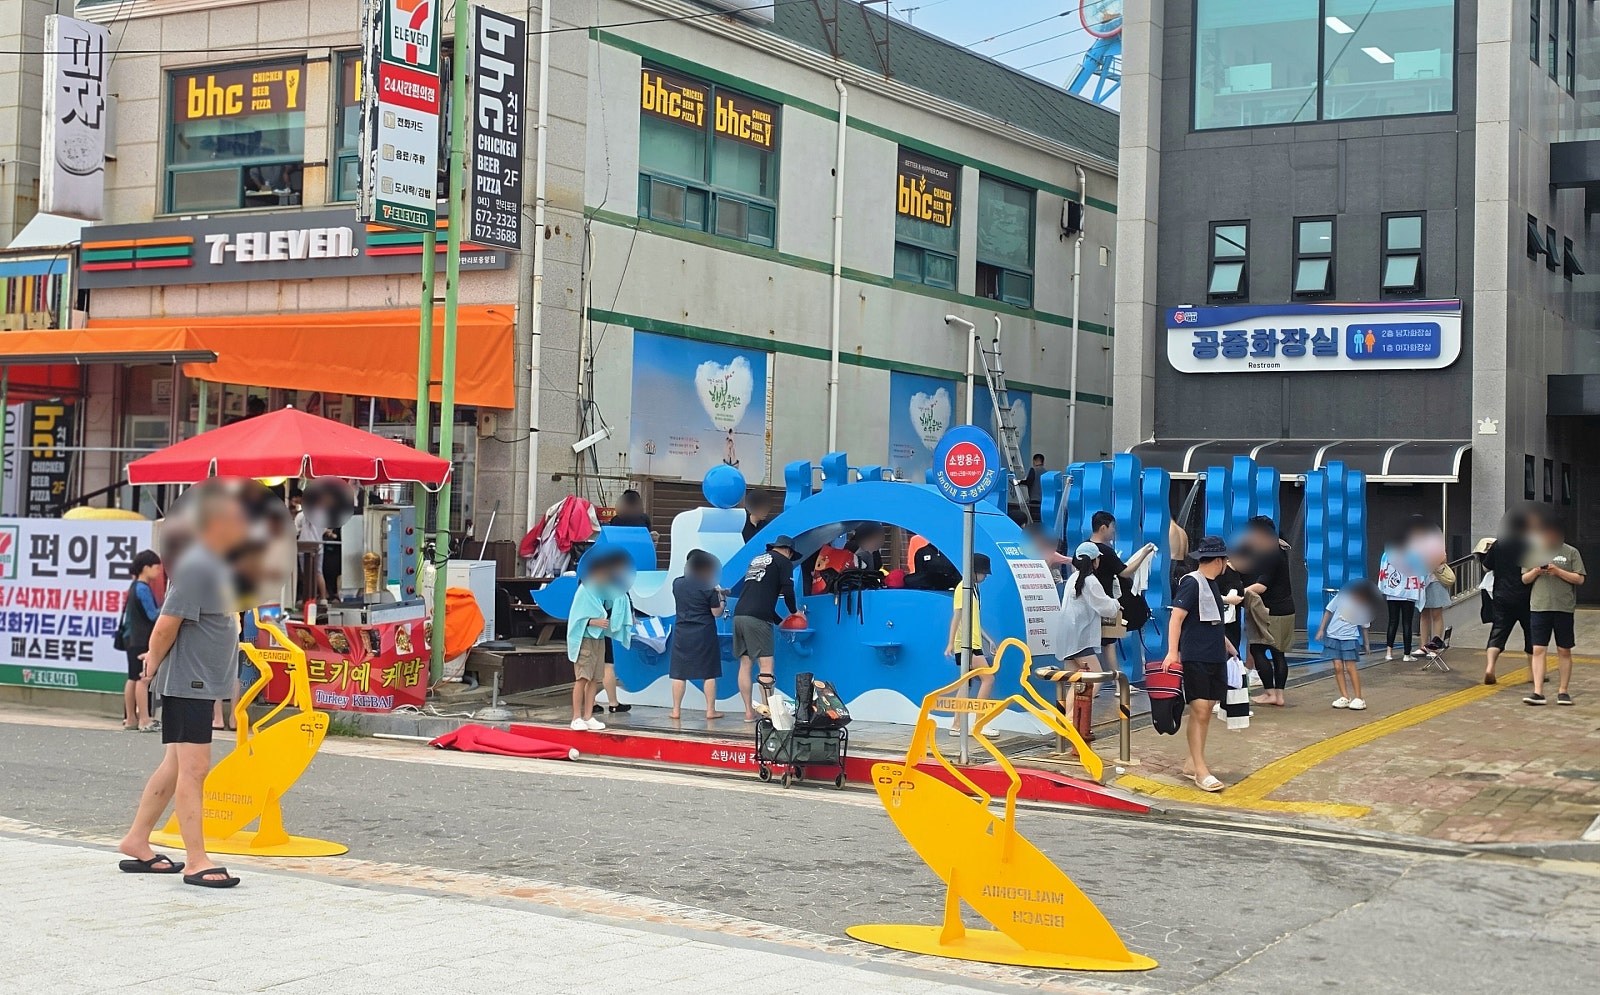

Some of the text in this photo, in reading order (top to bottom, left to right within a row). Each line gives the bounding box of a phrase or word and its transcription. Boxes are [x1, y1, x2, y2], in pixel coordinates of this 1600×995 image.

[252, 70, 283, 83] CHICKEN
[479, 14, 516, 133] bhc
[187, 75, 243, 119] bhc
[251, 85, 270, 97] BEER
[384, 77, 435, 102] 24시간편의점
[642, 72, 681, 118] bhc
[251, 98, 271, 111] PIZZA
[507, 91, 518, 136] 치킨
[397, 117, 424, 132] 전화카드
[715, 96, 751, 139] bhc
[477, 133, 517, 159] CHICKEN
[477, 154, 500, 175] BEER
[476, 174, 501, 196] PIZZA
[503, 168, 518, 188] 2F
[394, 182, 431, 199] 도시락/김밥
[899, 174, 933, 220] bhc
[475, 208, 517, 229] 672-2326
[475, 223, 517, 244] 672-3688
[1192, 327, 1339, 360] 공중화장실
[1381, 329, 1432, 338] 2층 남자화장실
[1382, 343, 1432, 353] 1층 여자화장실
[31, 461, 65, 473] CHICKEN
[949, 454, 981, 466] 소방용수
[51, 480, 65, 495] 2F
[29, 534, 138, 580] 편의점
[11, 636, 93, 662] 패스트푸드
[285, 659, 371, 694] 르키예
[382, 657, 425, 690] 케밥
[316, 690, 349, 706] Turkey
[711, 750, 746, 764] 소방시설
